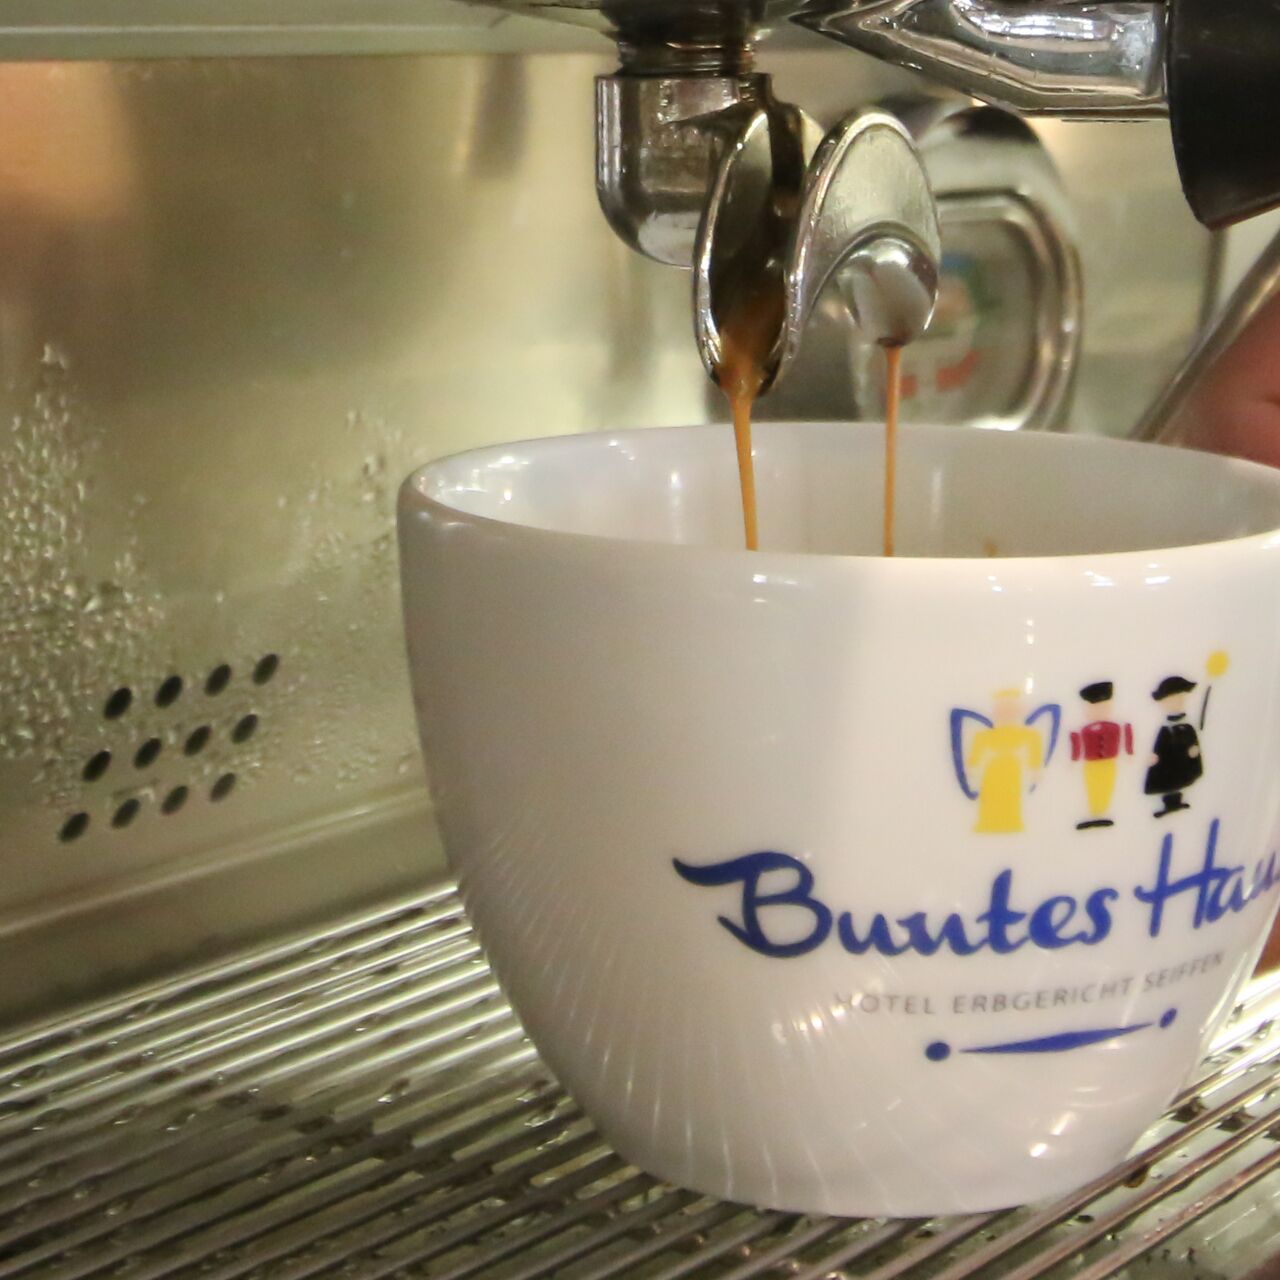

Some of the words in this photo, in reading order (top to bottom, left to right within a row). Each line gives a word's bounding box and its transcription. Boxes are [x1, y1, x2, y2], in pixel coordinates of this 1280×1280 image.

[671, 850, 1119, 959] Buntes
[833, 990, 936, 1016] HOTEL
[951, 976, 1134, 1016] ERBGERICHT
